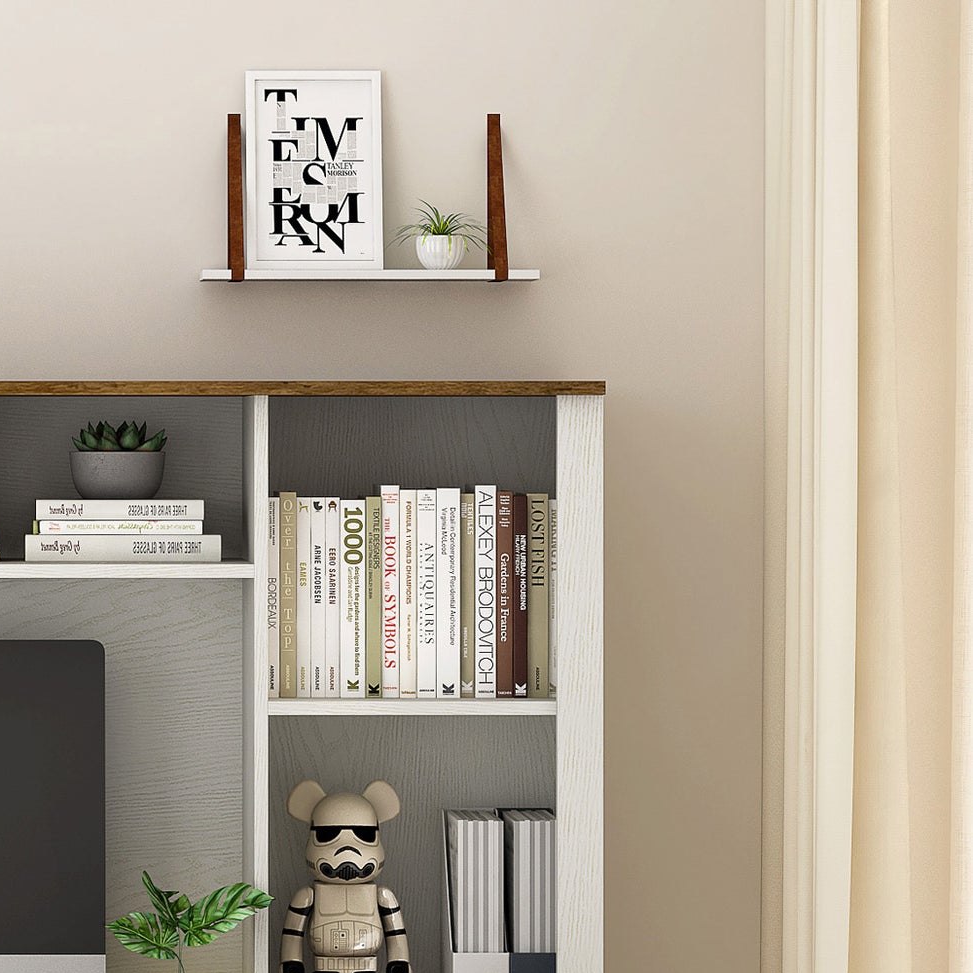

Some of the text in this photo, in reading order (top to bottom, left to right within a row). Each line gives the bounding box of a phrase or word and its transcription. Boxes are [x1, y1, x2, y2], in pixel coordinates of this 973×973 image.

[343, 507, 364, 565] 1000
[372, 508, 380, 569] TEXTILE DESIGNERS
[384, 536, 396, 577] BOOK
[530, 499, 545, 587] LOST FISH
[267, 577, 277, 630] BORDEAUX
[299, 562, 307, 587] EAMES
[314, 566, 322, 604] JACOBSEN
[328, 547, 336, 605] EERO SAARINEN
[423, 543, 434, 644] ANTIQUAIRES
[478, 491, 494, 684] ALEXEY BRODOVITCH
[500, 553, 509, 642] Gardens in France
[384, 594, 396, 669] SYMBOLS
